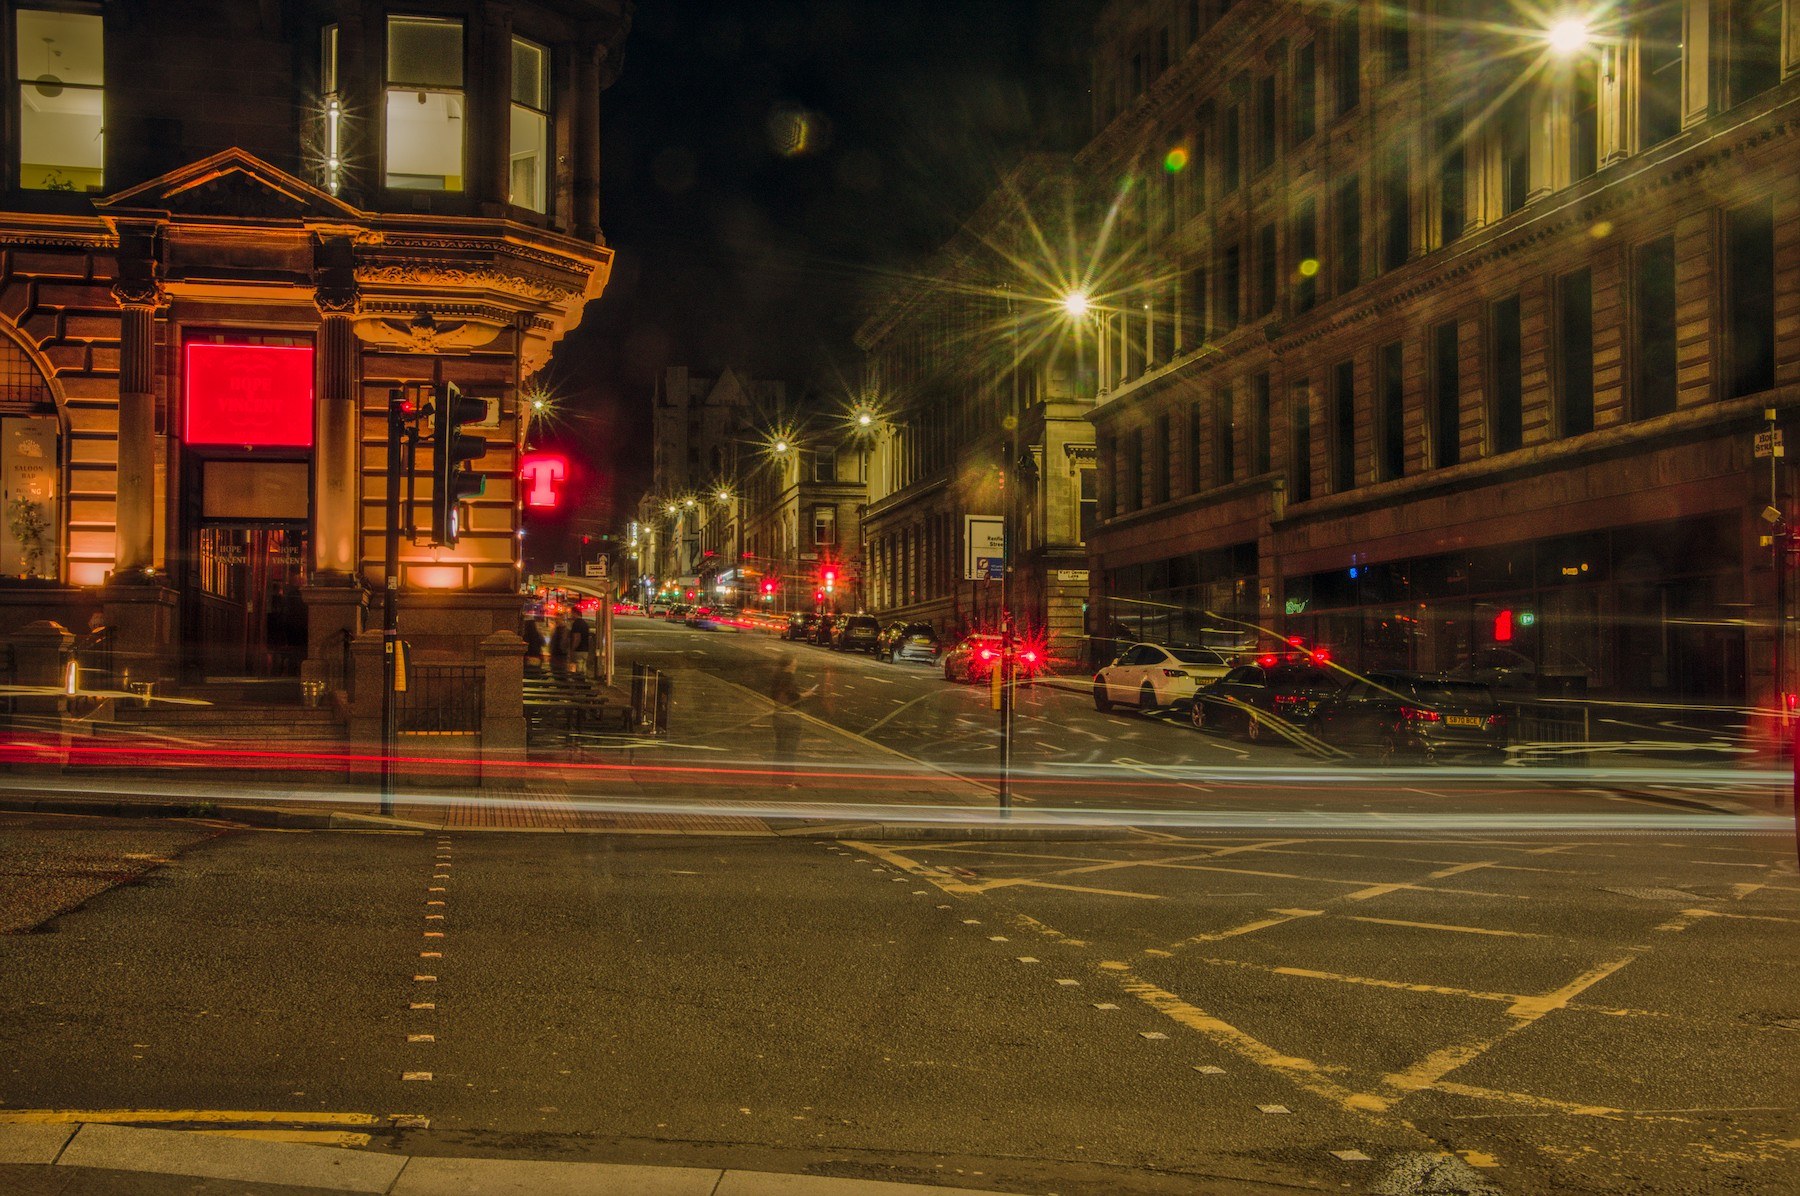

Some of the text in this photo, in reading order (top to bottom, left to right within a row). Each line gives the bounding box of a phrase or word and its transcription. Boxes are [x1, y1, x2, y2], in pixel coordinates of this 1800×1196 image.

[230, 377, 272, 391] HOPE
[218, 398, 283, 413] VINCENT
[523, 459, 564, 506] T
[214, 556, 247, 564] VINCENT
